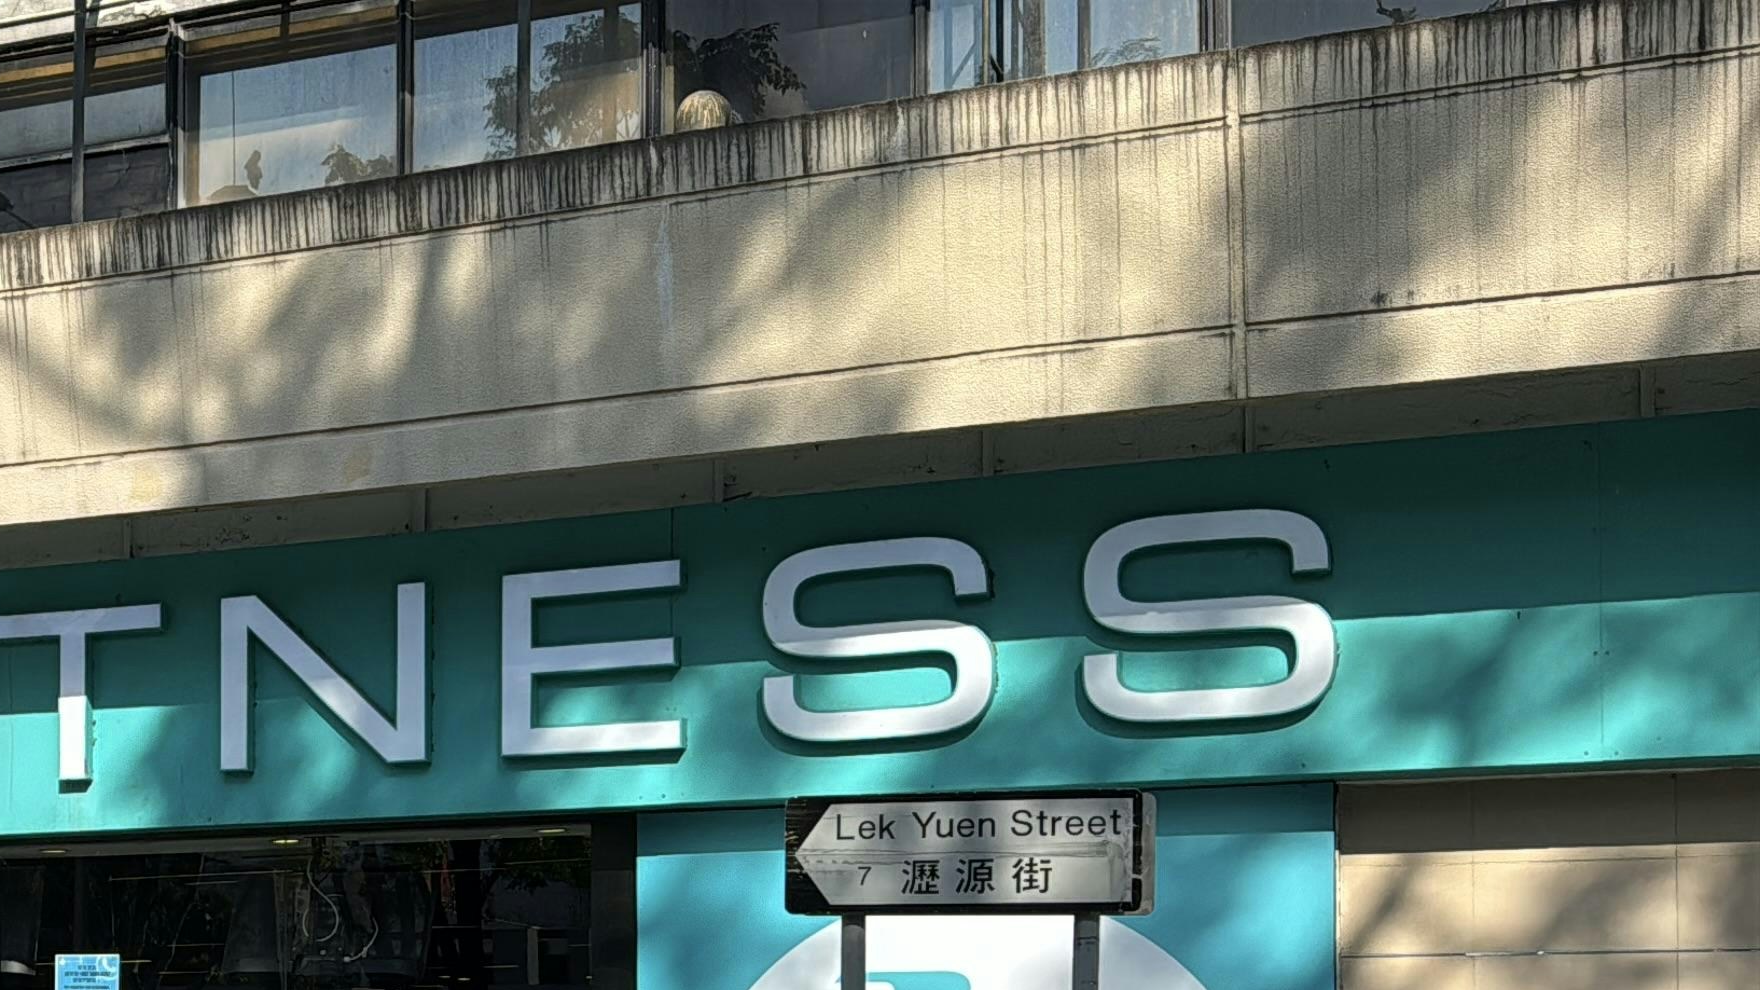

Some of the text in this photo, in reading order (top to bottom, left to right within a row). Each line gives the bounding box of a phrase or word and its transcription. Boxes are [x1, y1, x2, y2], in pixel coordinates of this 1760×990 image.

[835, 808, 1123, 841] Lek Yuen Street
[857, 857, 1053, 895] 7 瀝源街
